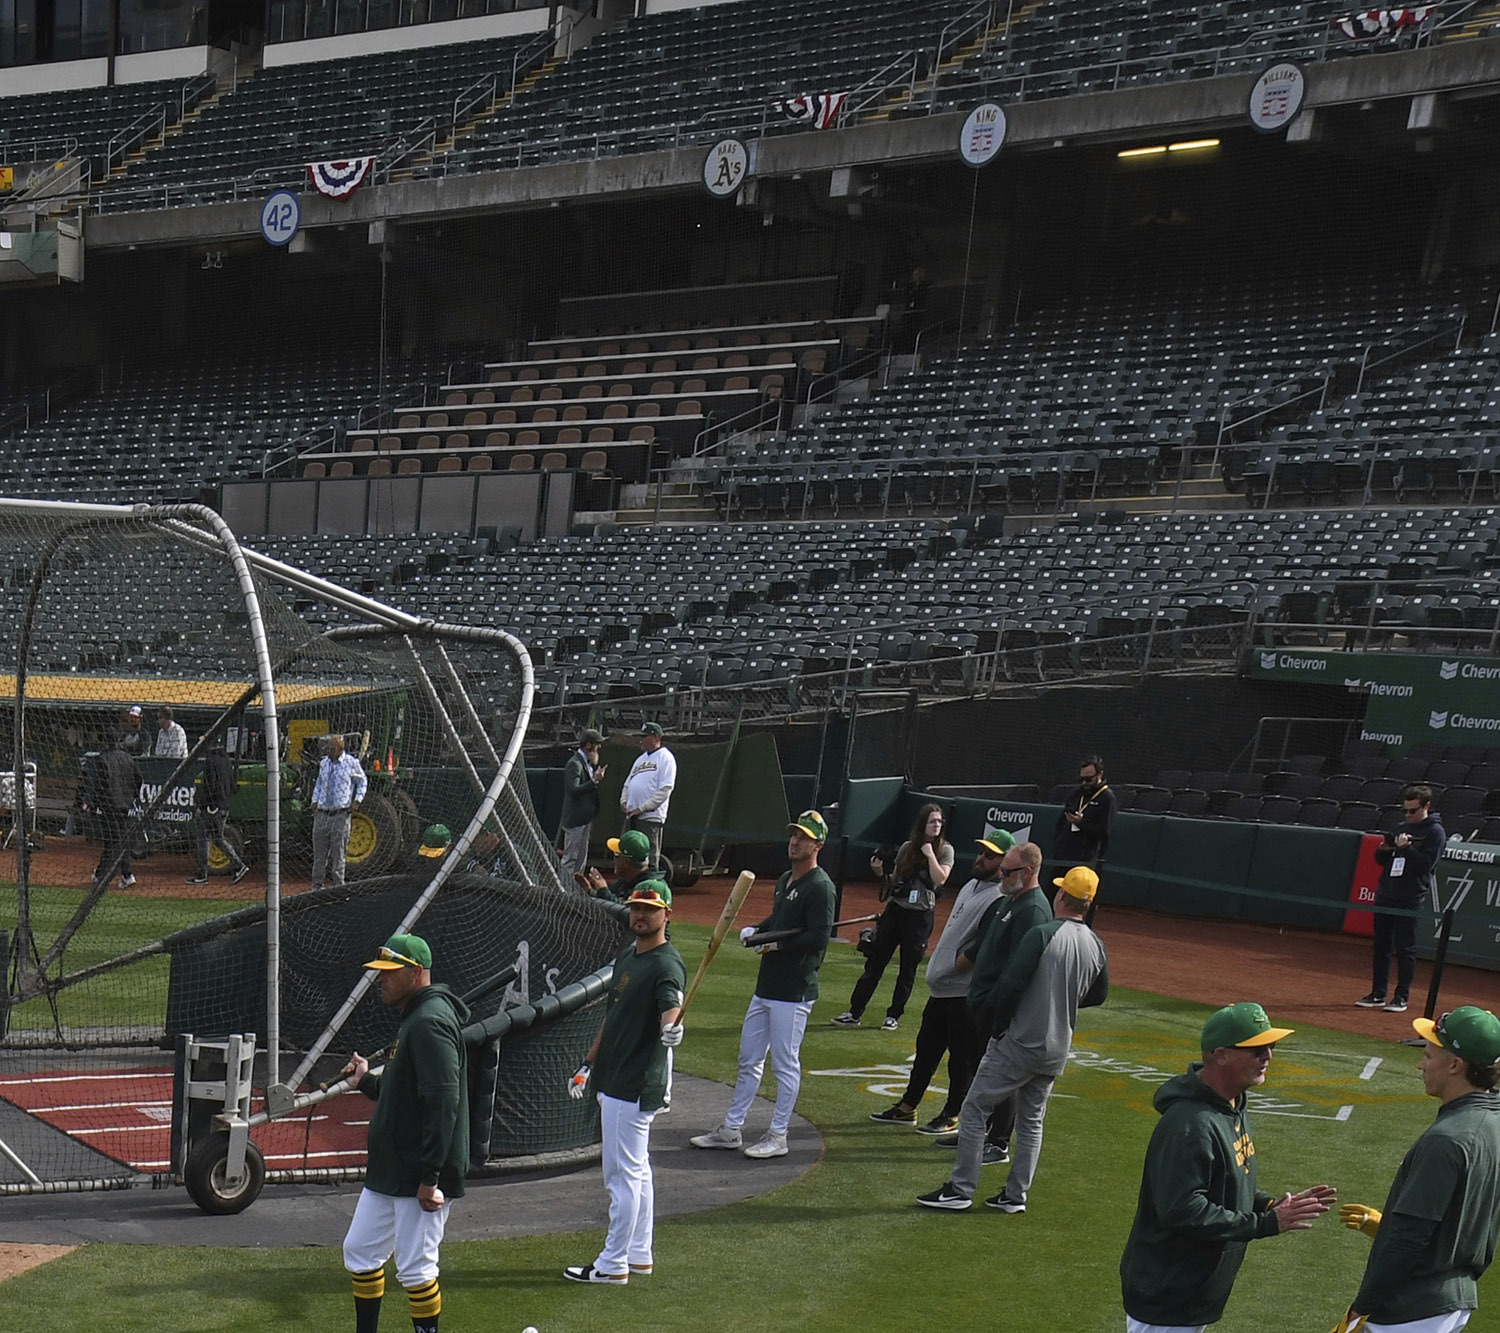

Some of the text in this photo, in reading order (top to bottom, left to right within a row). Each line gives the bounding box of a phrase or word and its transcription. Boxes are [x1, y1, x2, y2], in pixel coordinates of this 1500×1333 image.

[976, 109, 998, 123] KING
[712, 156, 741, 187] A's
[267, 204, 292, 231] 42
[1279, 656, 1327, 672] Chevron
[1360, 730, 1403, 746] hevron
[986, 806, 1034, 825] Chevron
